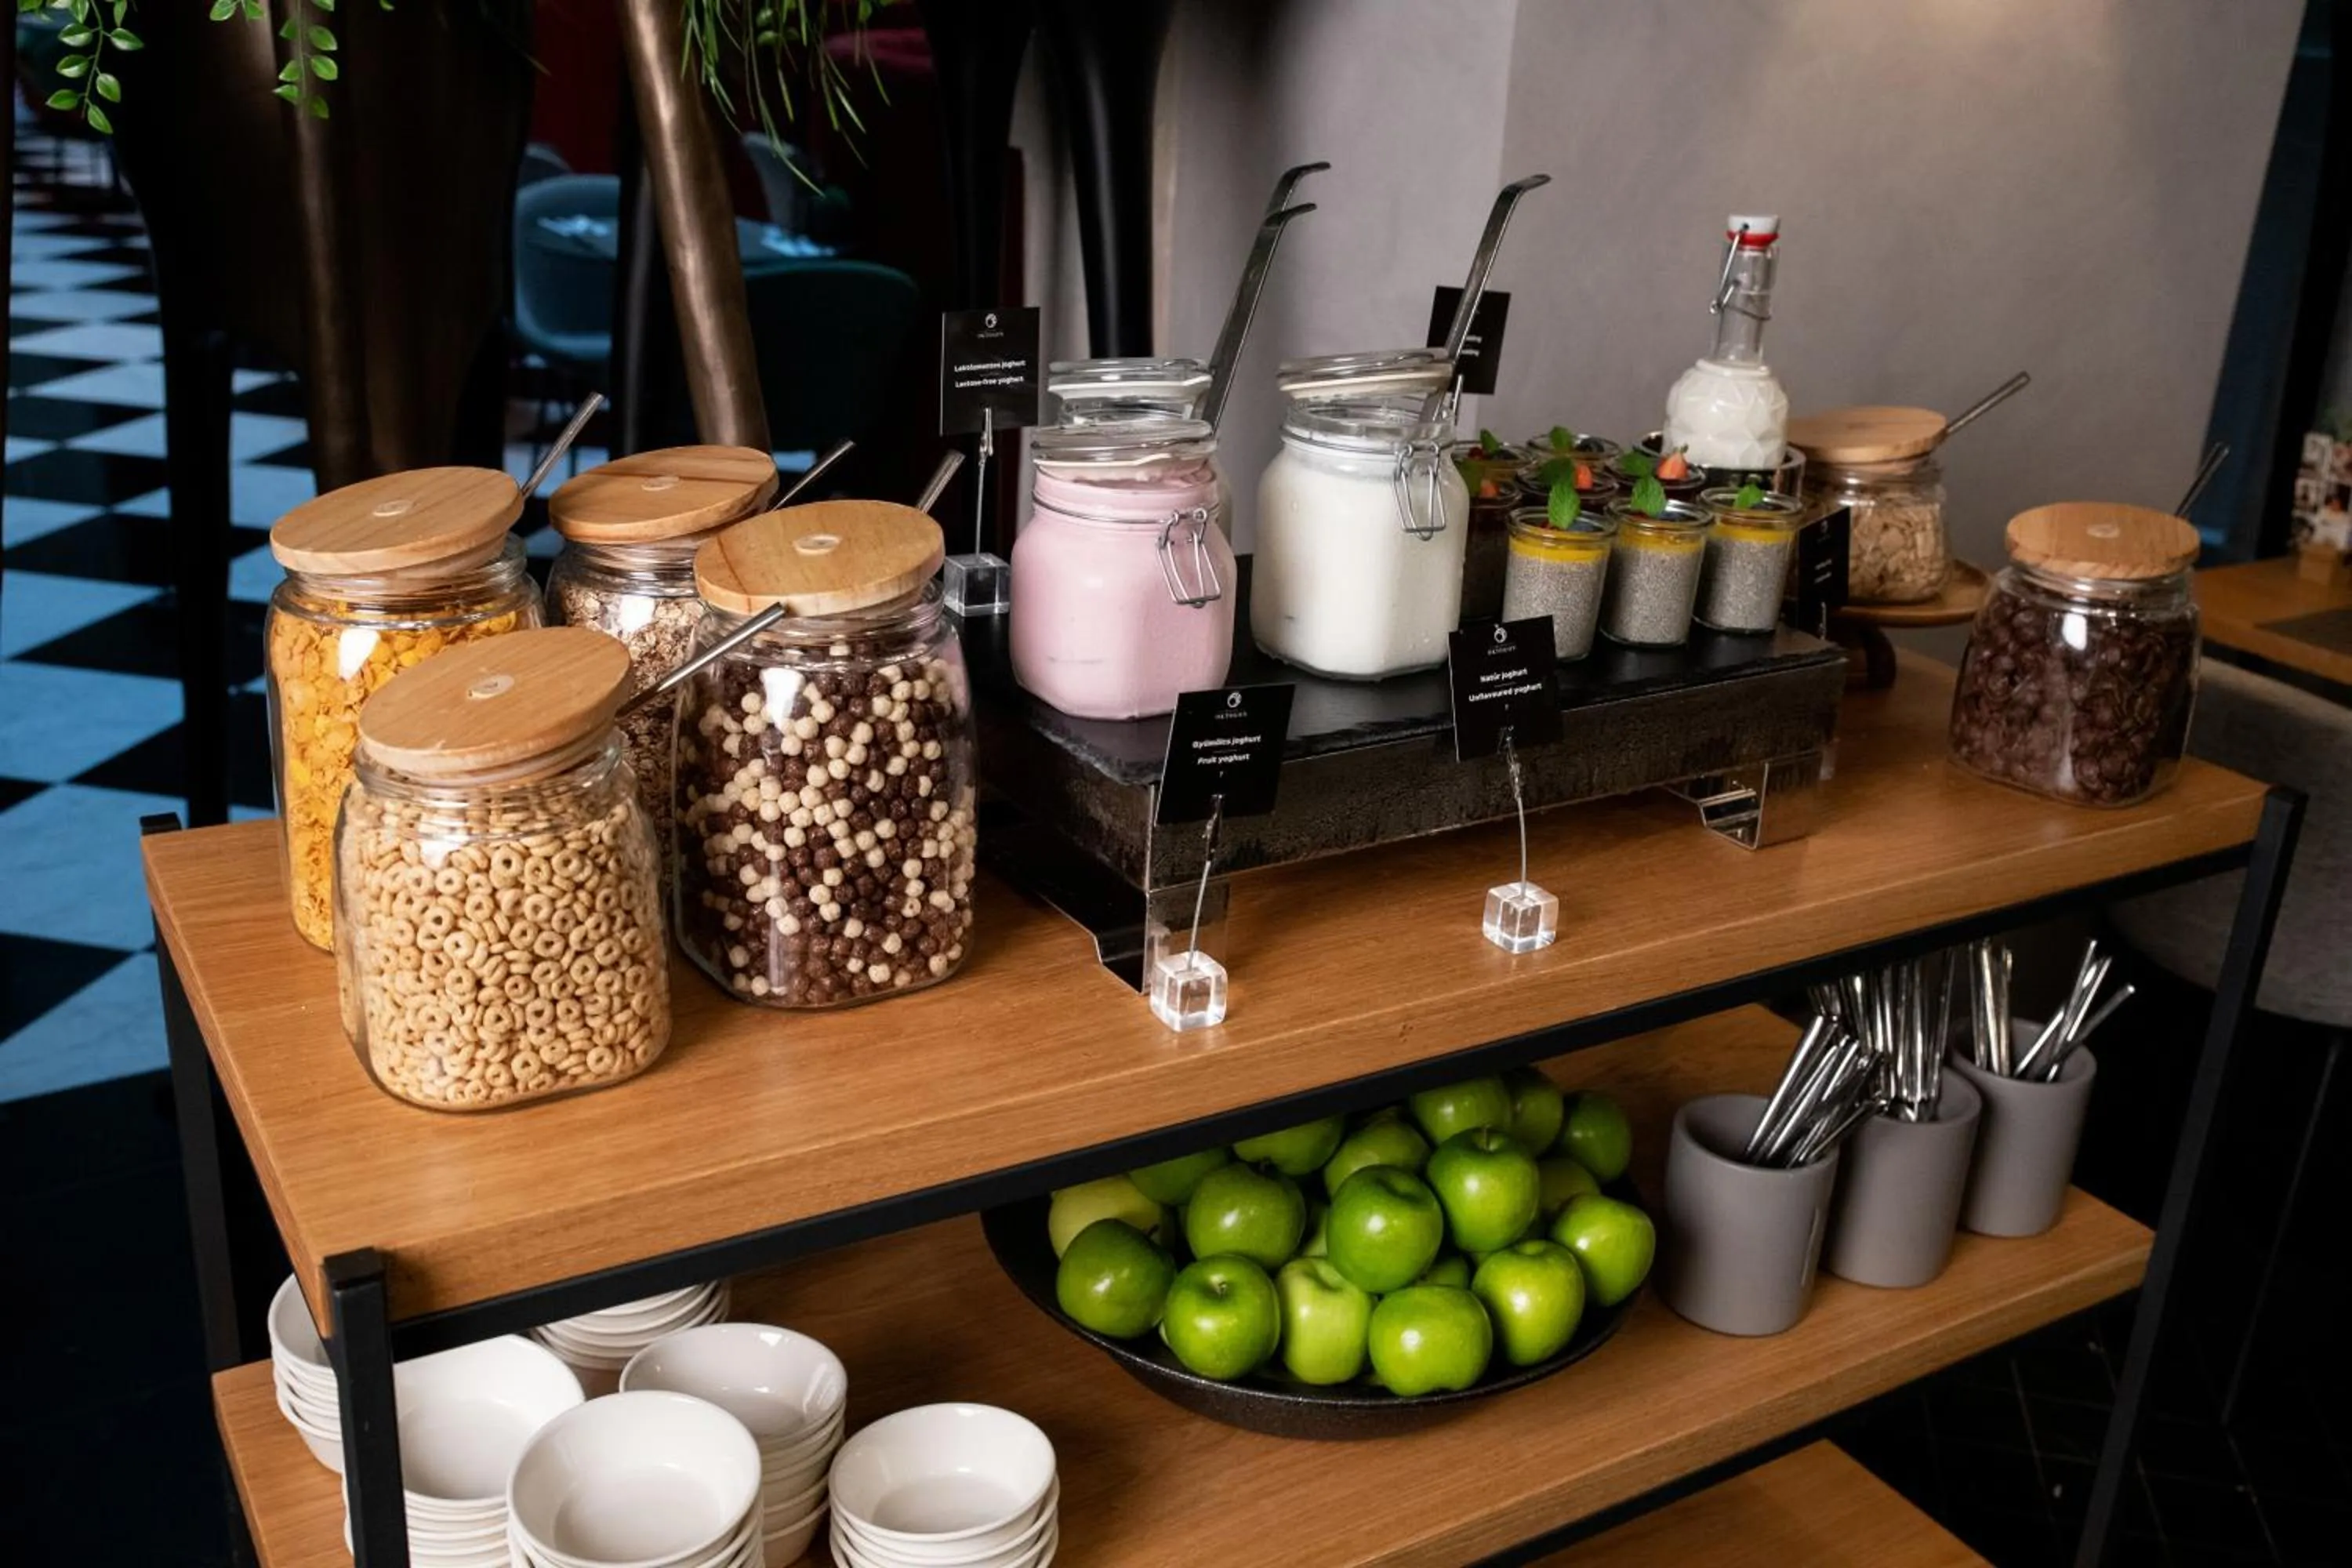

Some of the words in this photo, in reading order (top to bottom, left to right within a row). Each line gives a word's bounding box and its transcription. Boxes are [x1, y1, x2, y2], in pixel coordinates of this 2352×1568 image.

[1501, 667, 1528, 681] joghurt
[1468, 688, 1512, 702] Unflavoured
[1514, 683, 1542, 695] yoghurt
[1197, 757, 1217, 765] Fruit
[1218, 753, 1250, 764] yoghurt
